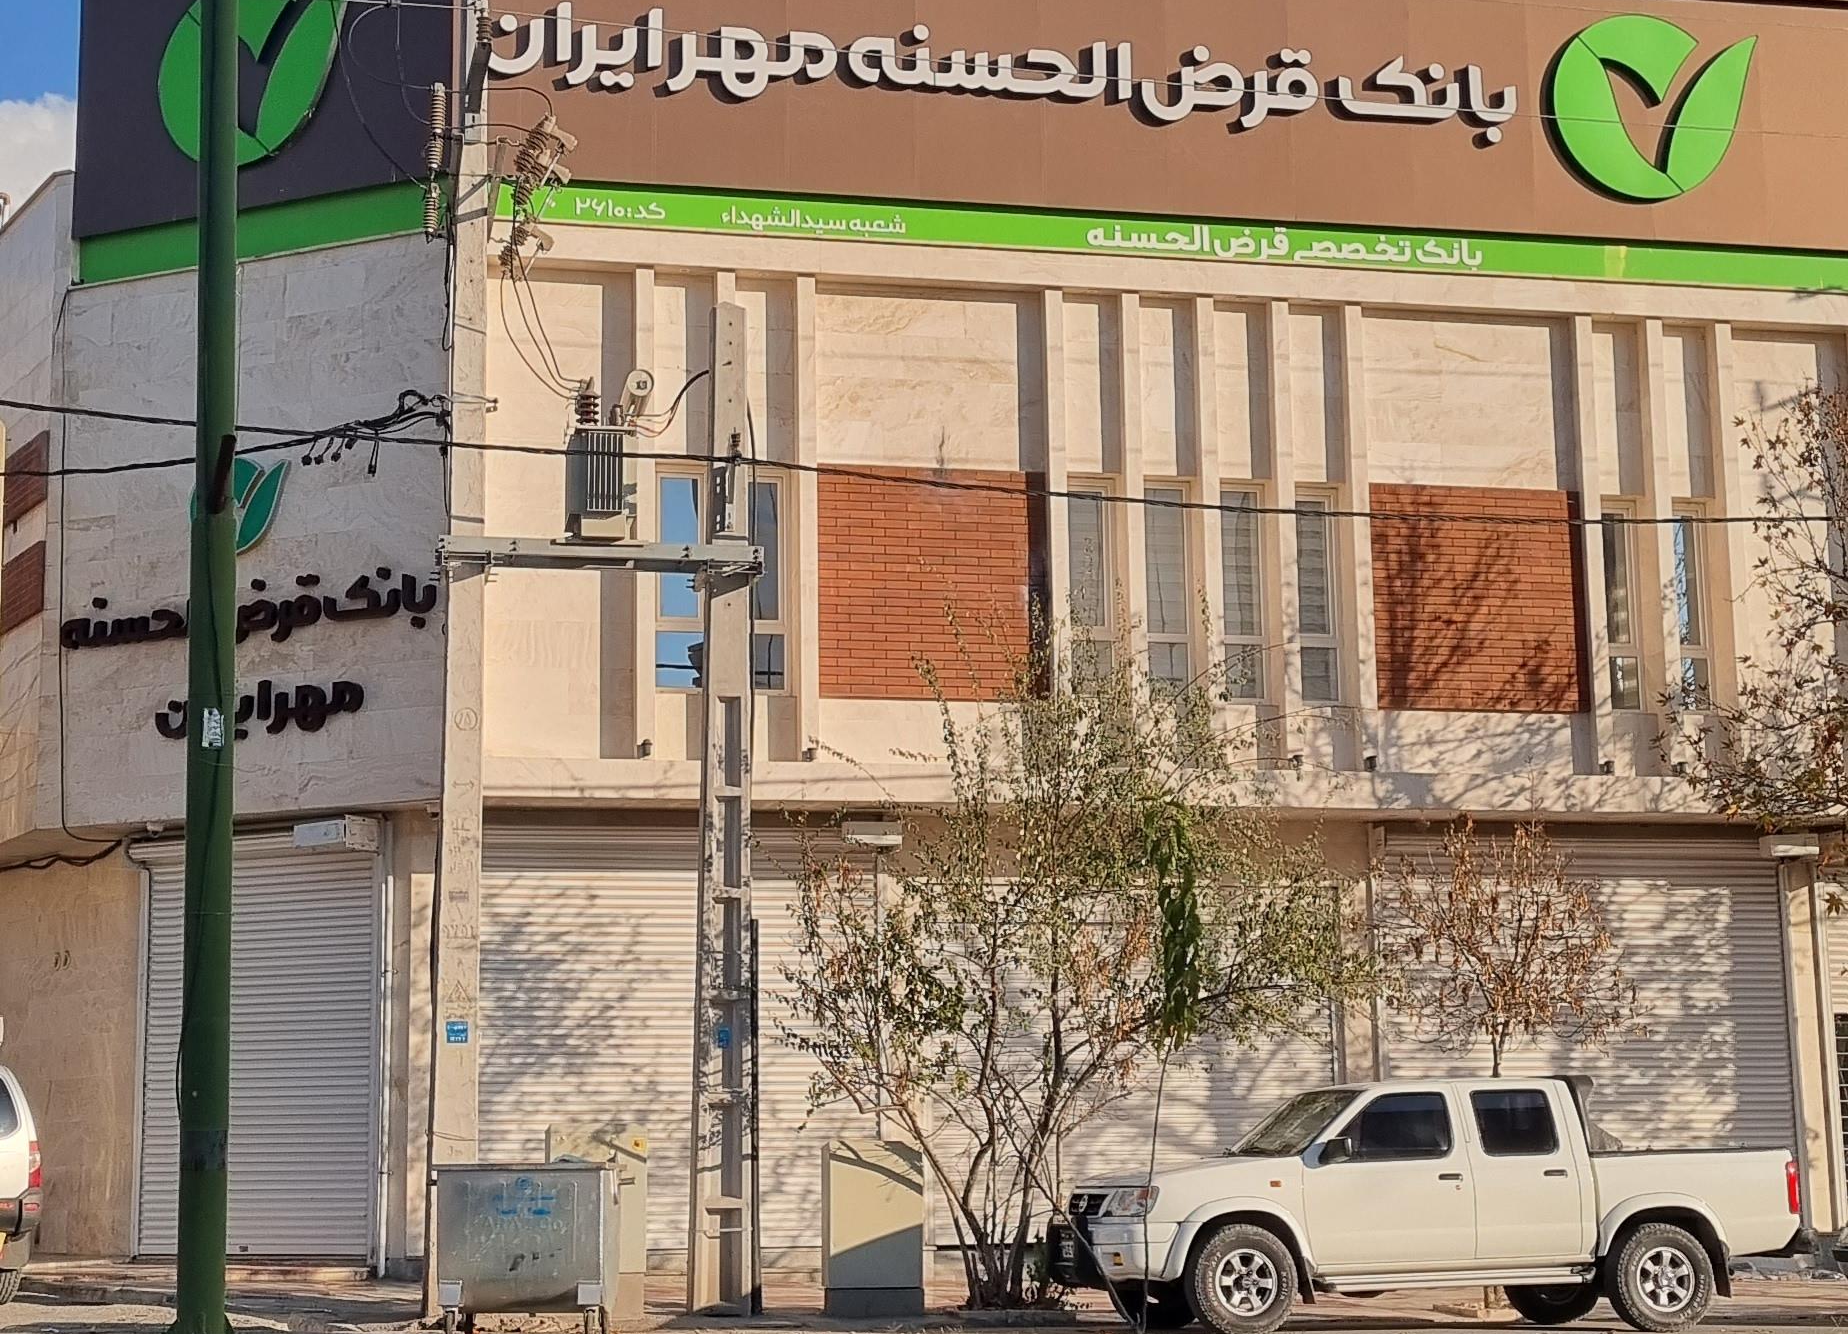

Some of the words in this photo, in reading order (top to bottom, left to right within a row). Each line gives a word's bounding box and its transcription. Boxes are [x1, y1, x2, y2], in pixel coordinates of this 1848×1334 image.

[487, 1, 663, 88] ایران
[666, 26, 838, 98] مهر
[848, 23, 1133, 99] الحسنه
[1141, 45, 1319, 129] قرض
[1338, 56, 1518, 144] بانک
[848, 214, 906, 237] شعبه
[1086, 224, 1210, 252] الحسنه
[1213, 227, 1289, 260] قرض
[1415, 238, 1483, 270] بانک
[60, 597, 189, 649] حسنه
[322, 566, 437, 629] بانک
[265, 680, 364, 734] مهر
